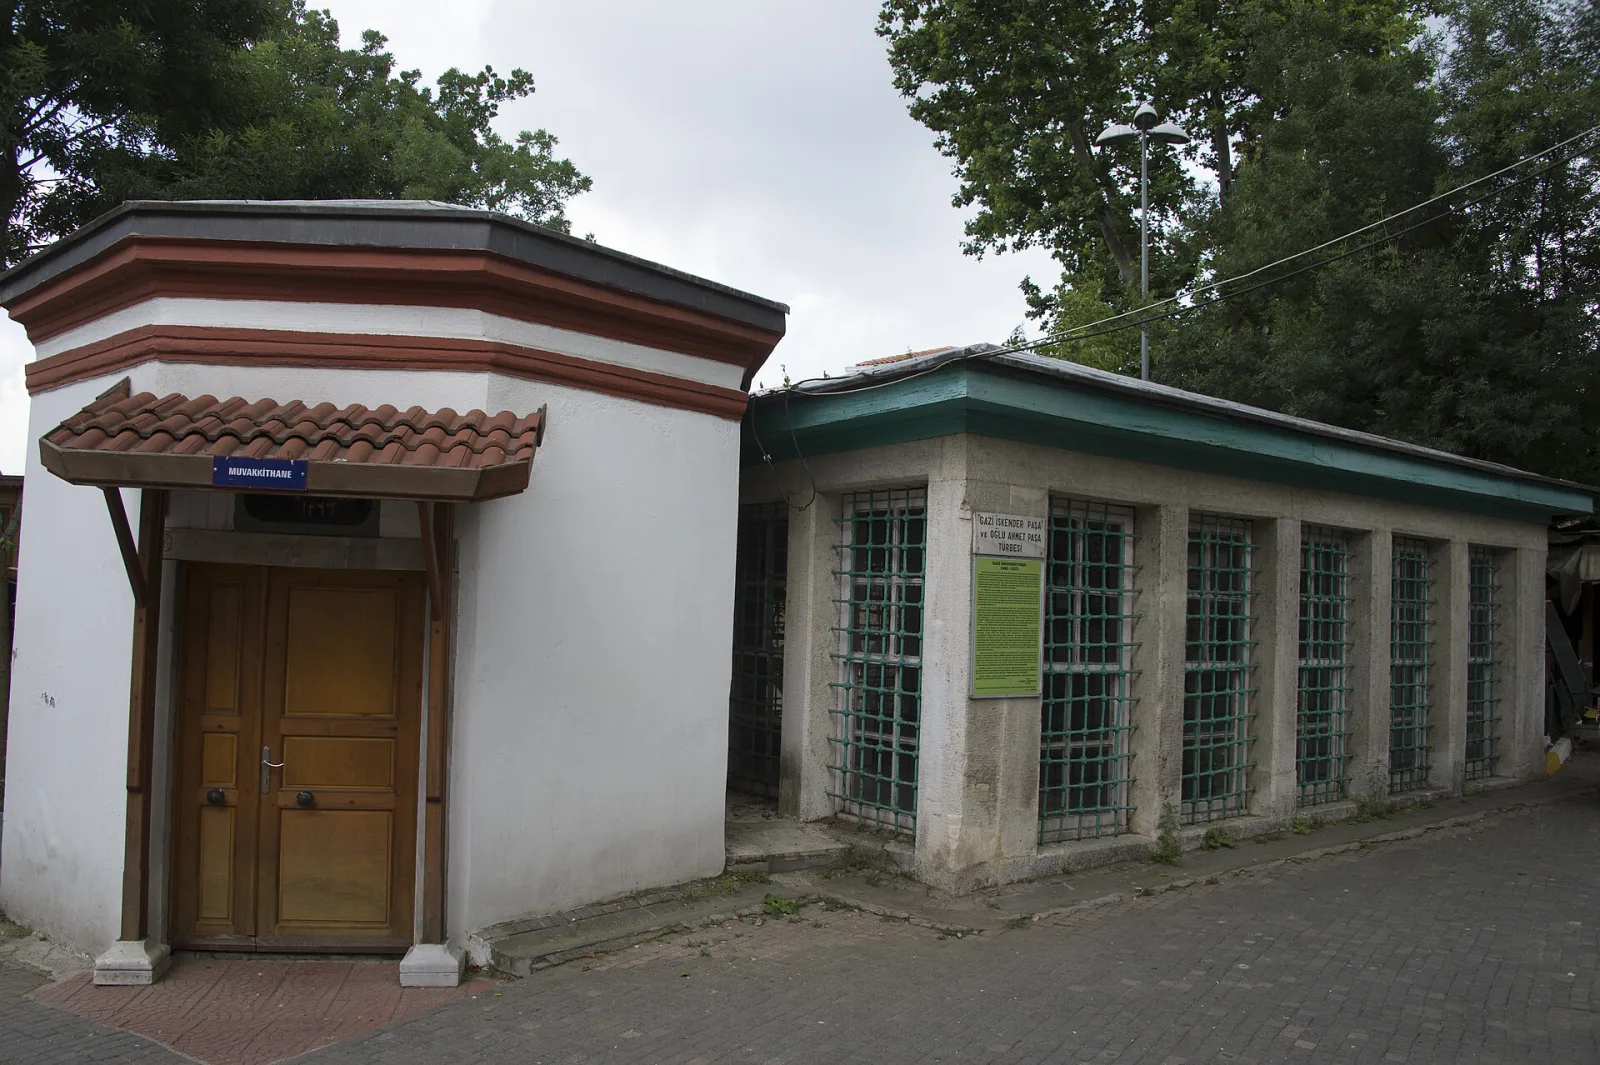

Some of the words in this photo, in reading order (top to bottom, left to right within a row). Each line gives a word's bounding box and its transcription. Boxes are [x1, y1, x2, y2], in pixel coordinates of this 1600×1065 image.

[228, 466, 292, 479] MUVAKKİTHANE
[979, 515, 994, 526] GAZİ
[995, 514, 1024, 529] İSKENDER
[1027, 520, 1042, 531] PAŞA
[990, 527, 1006, 540] OĞLU
[1007, 531, 1026, 542] AHMET
[1027, 533, 1042, 543] PAŞA
[998, 541, 1023, 553] TÜRBESİ
